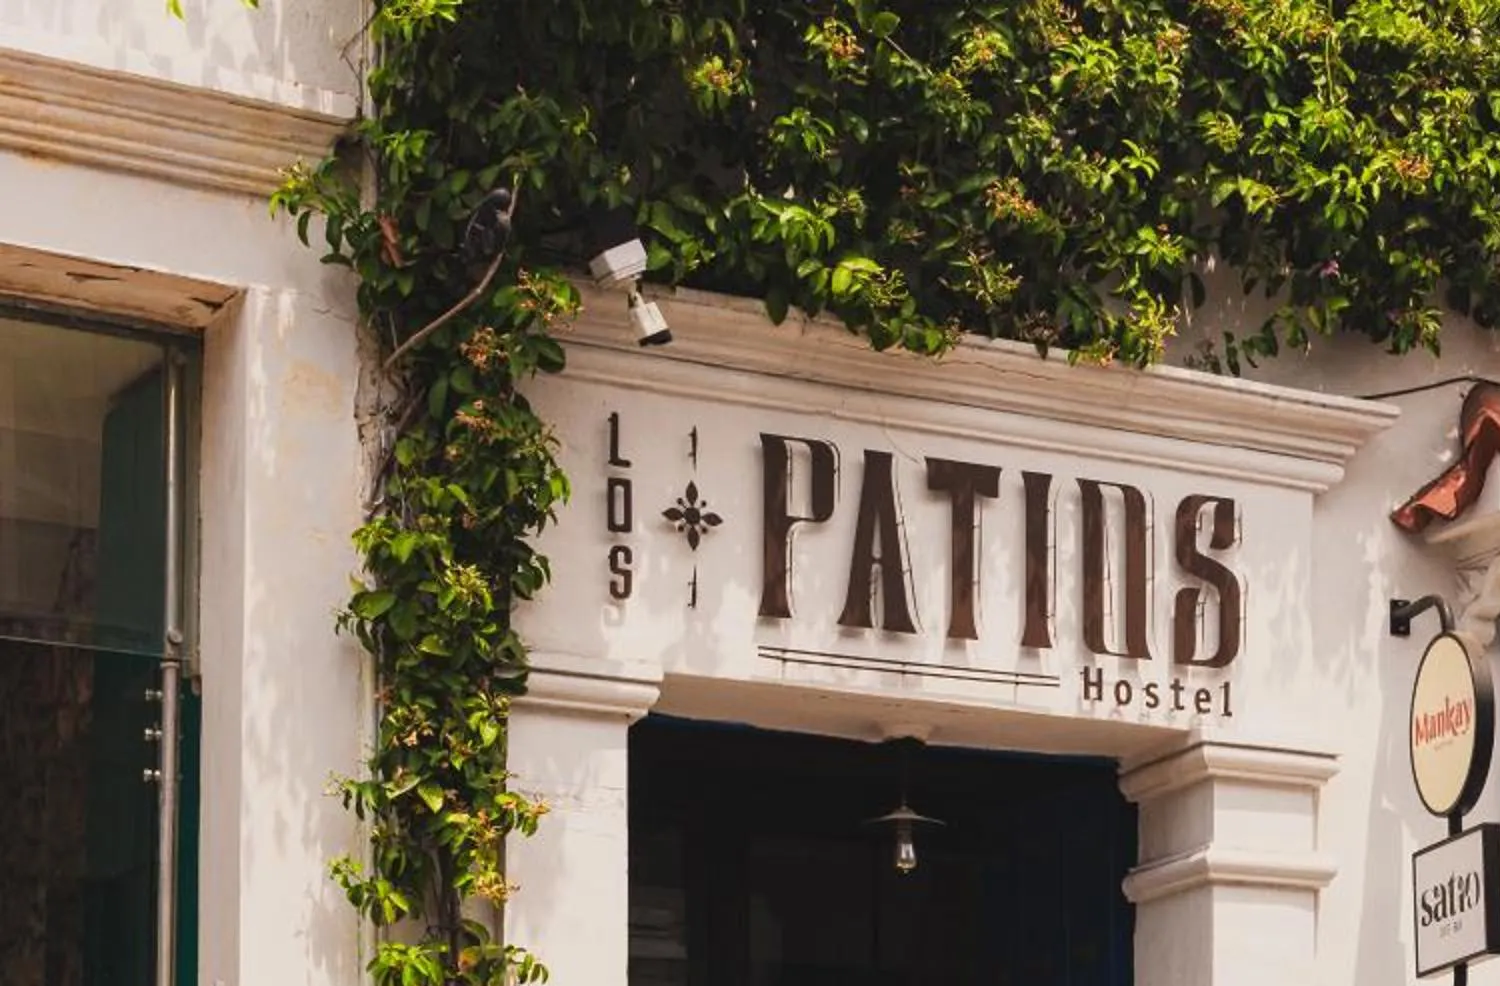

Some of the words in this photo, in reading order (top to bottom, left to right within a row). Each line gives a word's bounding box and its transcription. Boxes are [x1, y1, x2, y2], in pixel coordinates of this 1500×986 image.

[606, 411, 633, 600] LOS
[758, 432, 1243, 668] PATIOS
[1080, 665, 1233, 717] Hostel
